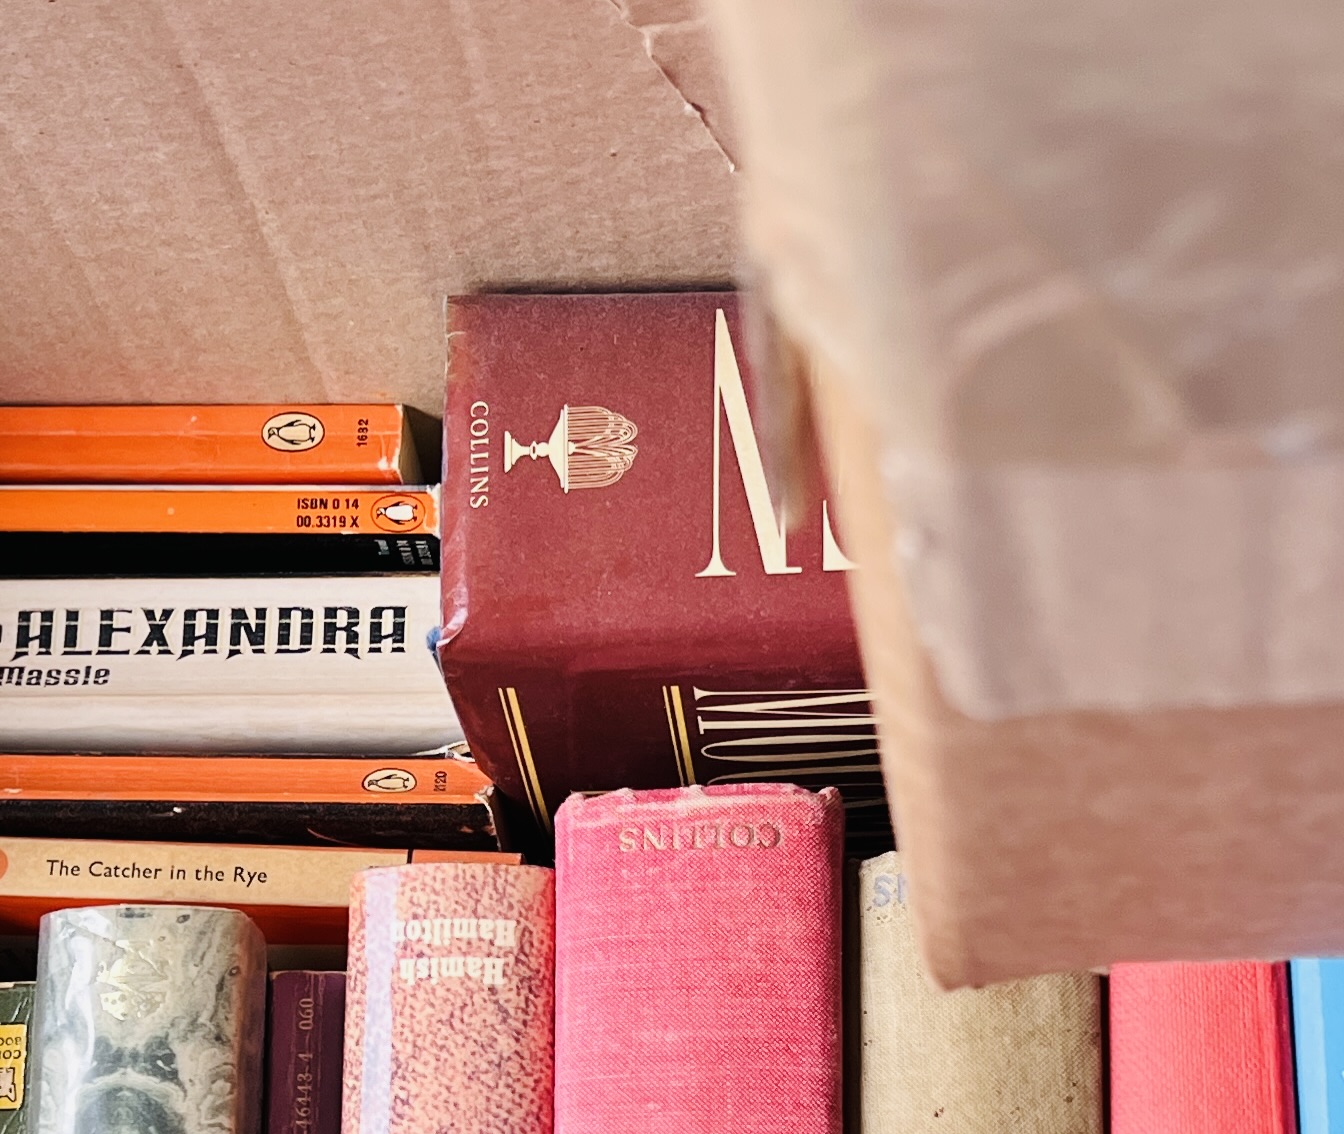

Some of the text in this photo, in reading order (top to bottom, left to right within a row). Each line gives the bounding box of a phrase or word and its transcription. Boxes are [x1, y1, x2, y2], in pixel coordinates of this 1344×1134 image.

[469, 400, 490, 509] COLLINS
[297, 497, 360, 511] ISBN 14
[349, 514, 361, 529] X
[10, 605, 409, 661] ALEXANDRA
[619, 820, 783, 852] COLLINS
[46, 859, 268, 888] The Catcher in the Rye
[389, 918, 518, 949] Hamilton
[399, 956, 509, 988] Hamish
